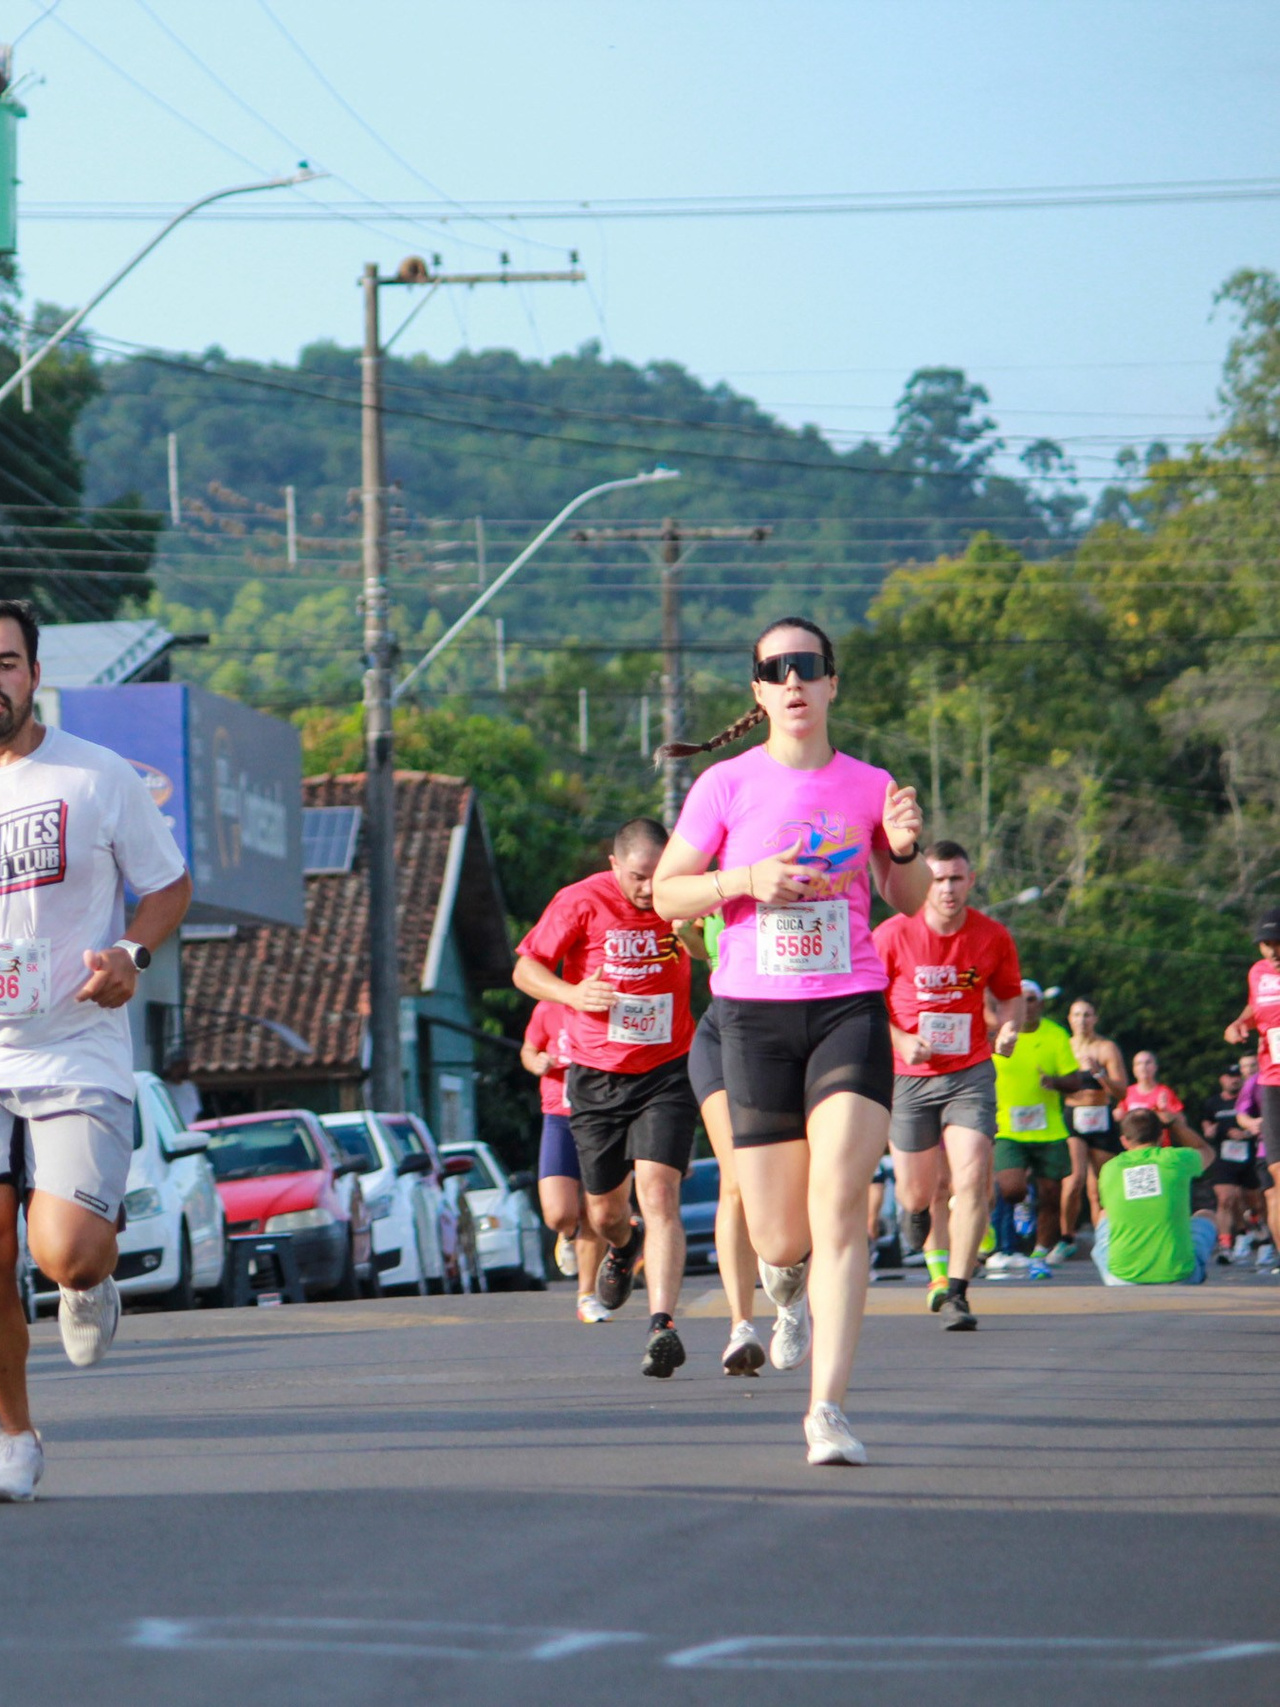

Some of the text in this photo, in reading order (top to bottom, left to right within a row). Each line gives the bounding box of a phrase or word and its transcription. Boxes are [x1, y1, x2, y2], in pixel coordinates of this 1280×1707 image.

[13, 847, 60, 876] CLUB
[776, 918, 804, 931] CUCA
[603, 938, 660, 957] CUCA
[775, 934, 823, 957] 5586
[26, 963, 39, 973] 5K
[622, 1015, 657, 1031] 5407
